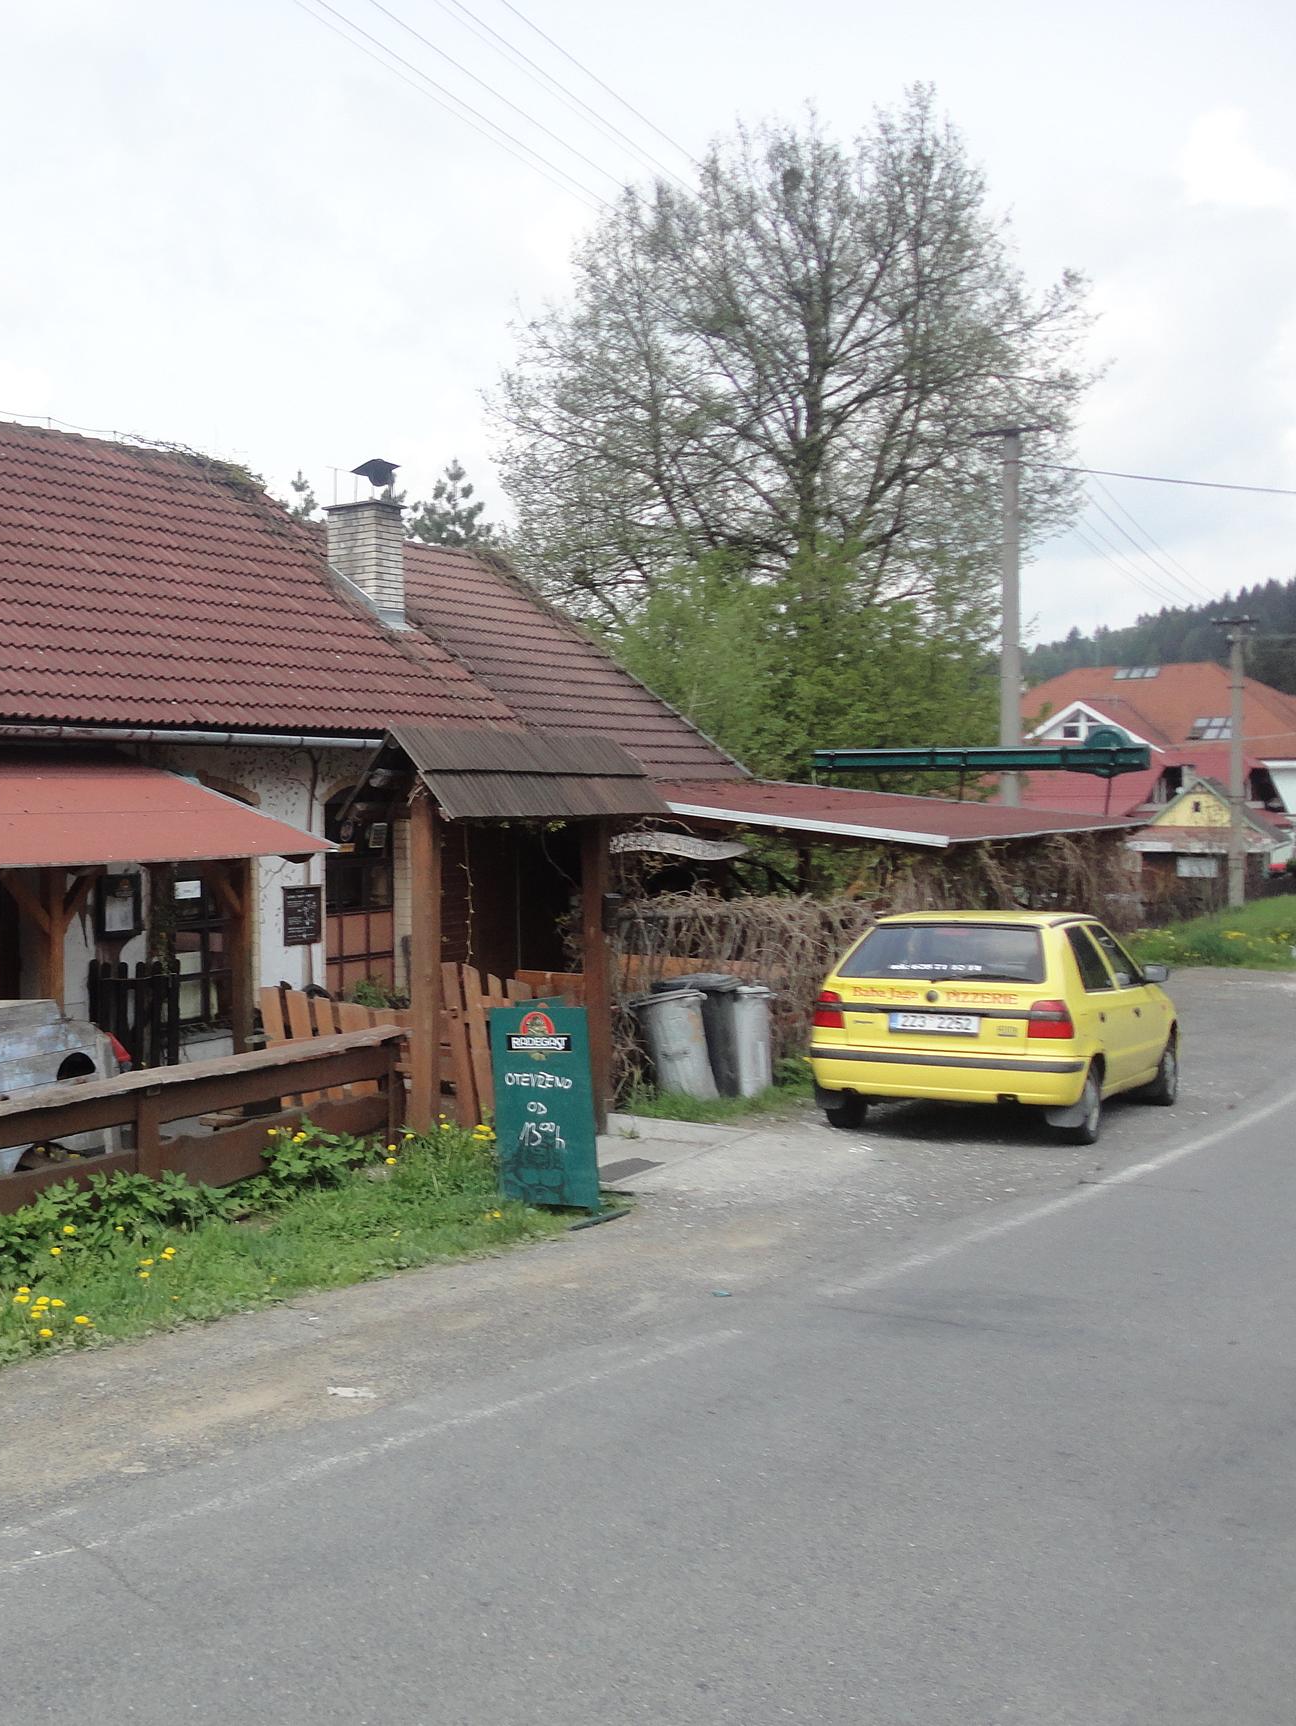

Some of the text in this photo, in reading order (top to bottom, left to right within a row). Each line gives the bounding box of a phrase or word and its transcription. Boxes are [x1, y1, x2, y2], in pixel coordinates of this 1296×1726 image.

[946, 990, 1019, 1004] PIZZERIE
[511, 1036, 568, 1050] RADEGAST
[526, 1101, 548, 1115] OD
